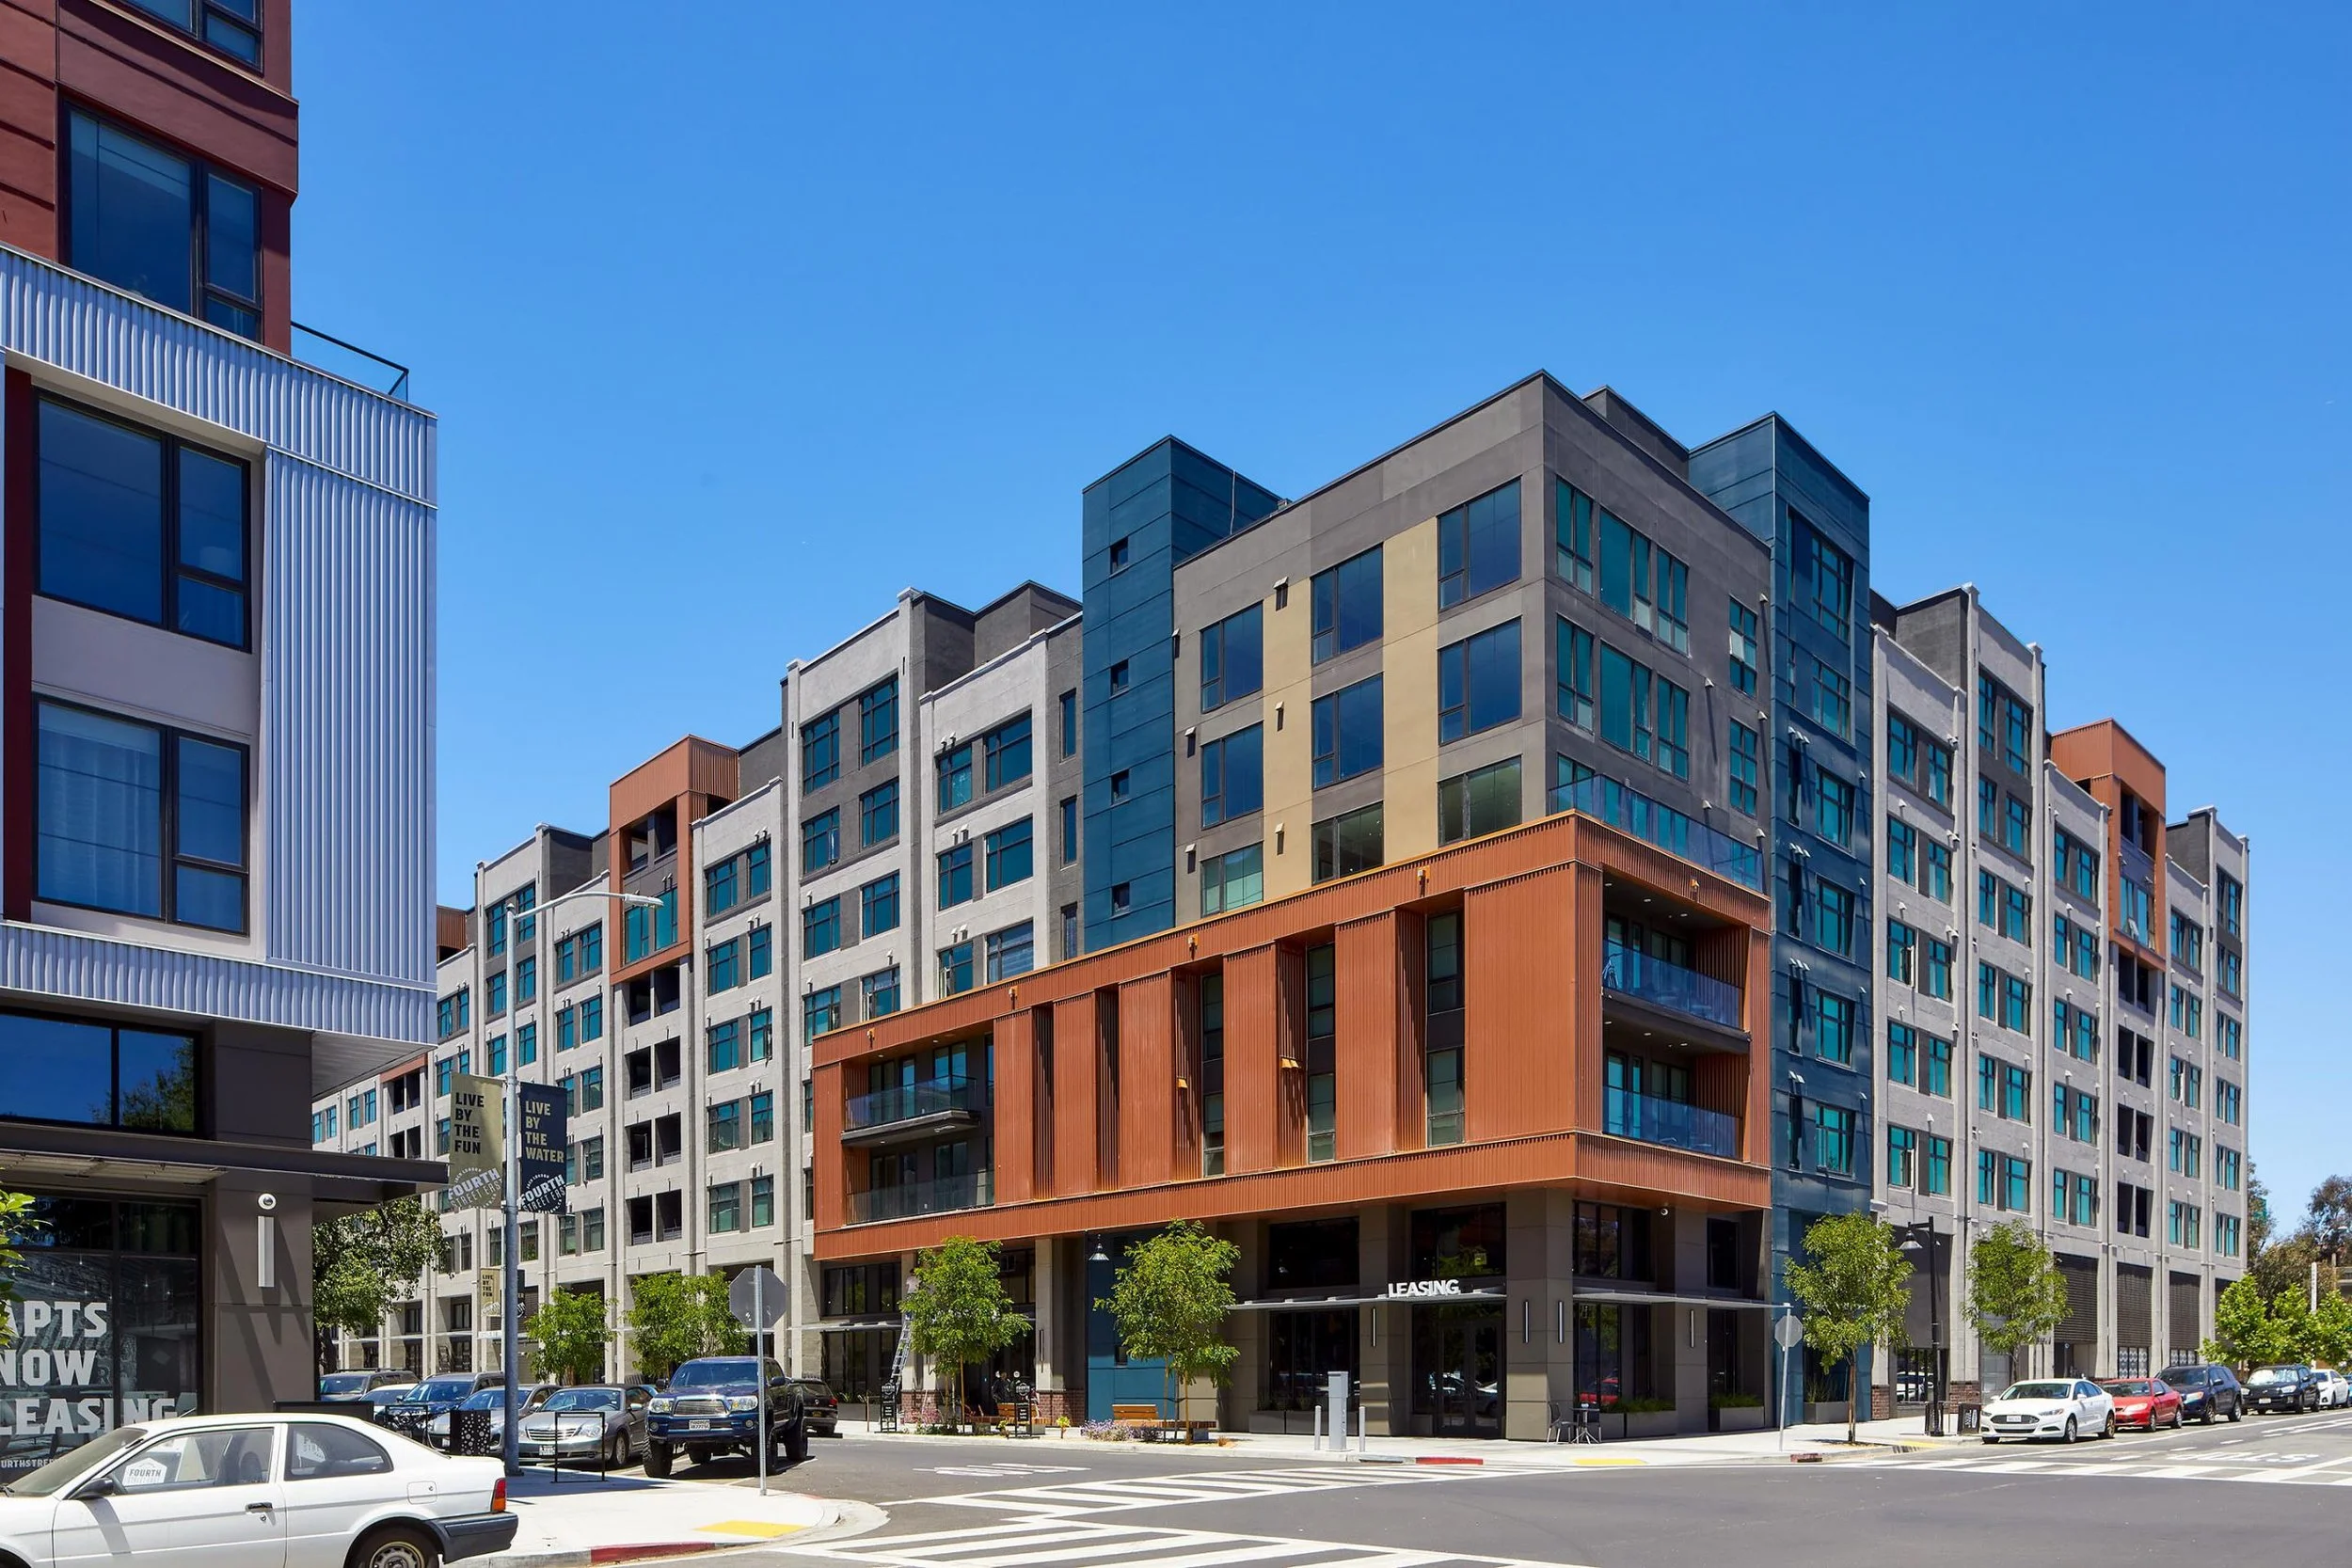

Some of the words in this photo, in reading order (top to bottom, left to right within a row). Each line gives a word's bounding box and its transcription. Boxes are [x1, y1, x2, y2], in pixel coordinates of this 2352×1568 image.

[455, 1092, 485, 1108] LIVE
[455, 1108, 472, 1122] BY
[525, 1101, 551, 1116] LIVE
[454, 1123, 480, 1139] THE
[525, 1116, 540, 1130] BY
[454, 1139, 481, 1155] FUN
[525, 1132, 548, 1147] THE
[525, 1147, 564, 1164] WATER
[448, 1167, 501, 1200] FOURTH
[519, 1174, 565, 1206] FOURTH
[450, 1189, 483, 1209] STREET
[522, 1194, 550, 1212] STREET
[549, 1184, 567, 1201] EAS
[1388, 1279, 1460, 1298] LEASING
[0, 1349, 97, 1386] NOW
[129, 1468, 162, 1477] FOURTH
